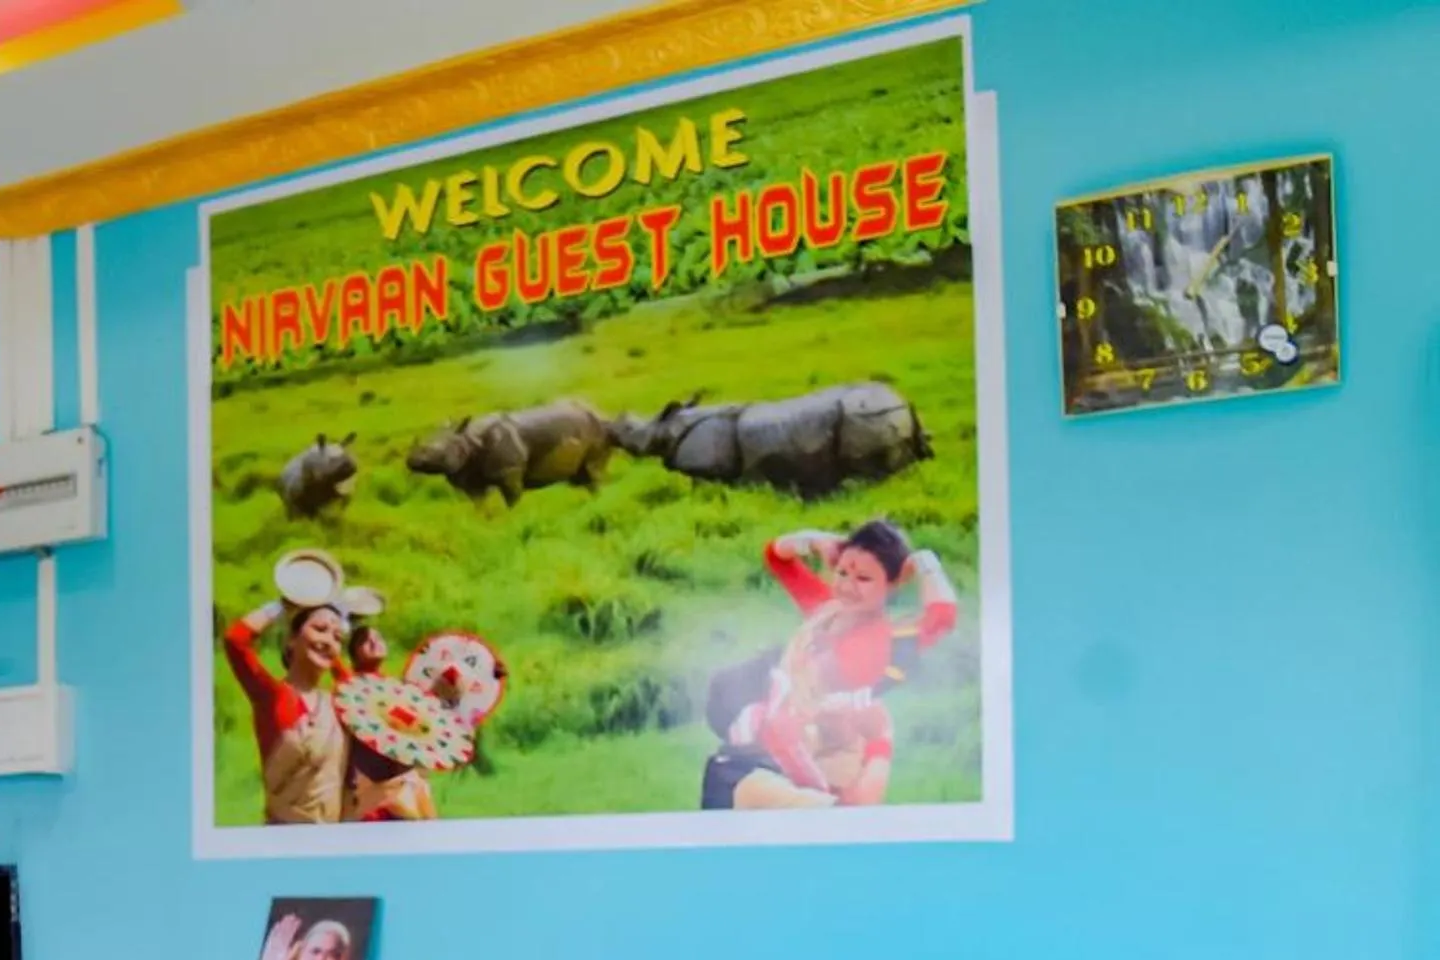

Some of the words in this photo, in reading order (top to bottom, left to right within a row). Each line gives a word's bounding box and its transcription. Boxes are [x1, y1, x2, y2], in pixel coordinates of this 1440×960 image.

[369, 107, 749, 240] WELCOME
[1125, 206, 1154, 232] 11
[1281, 211, 1303, 239] 2
[220, 253, 448, 367] NIRVAAN
[475, 203, 681, 313] GUEST
[709, 152, 949, 277] HOUSE
[1082, 243, 1117, 270] 10
[1075, 297, 1096, 321] 9
[1094, 342, 1115, 366] 8
[1138, 367, 1157, 391] 7
[1186, 369, 1208, 393] 6
